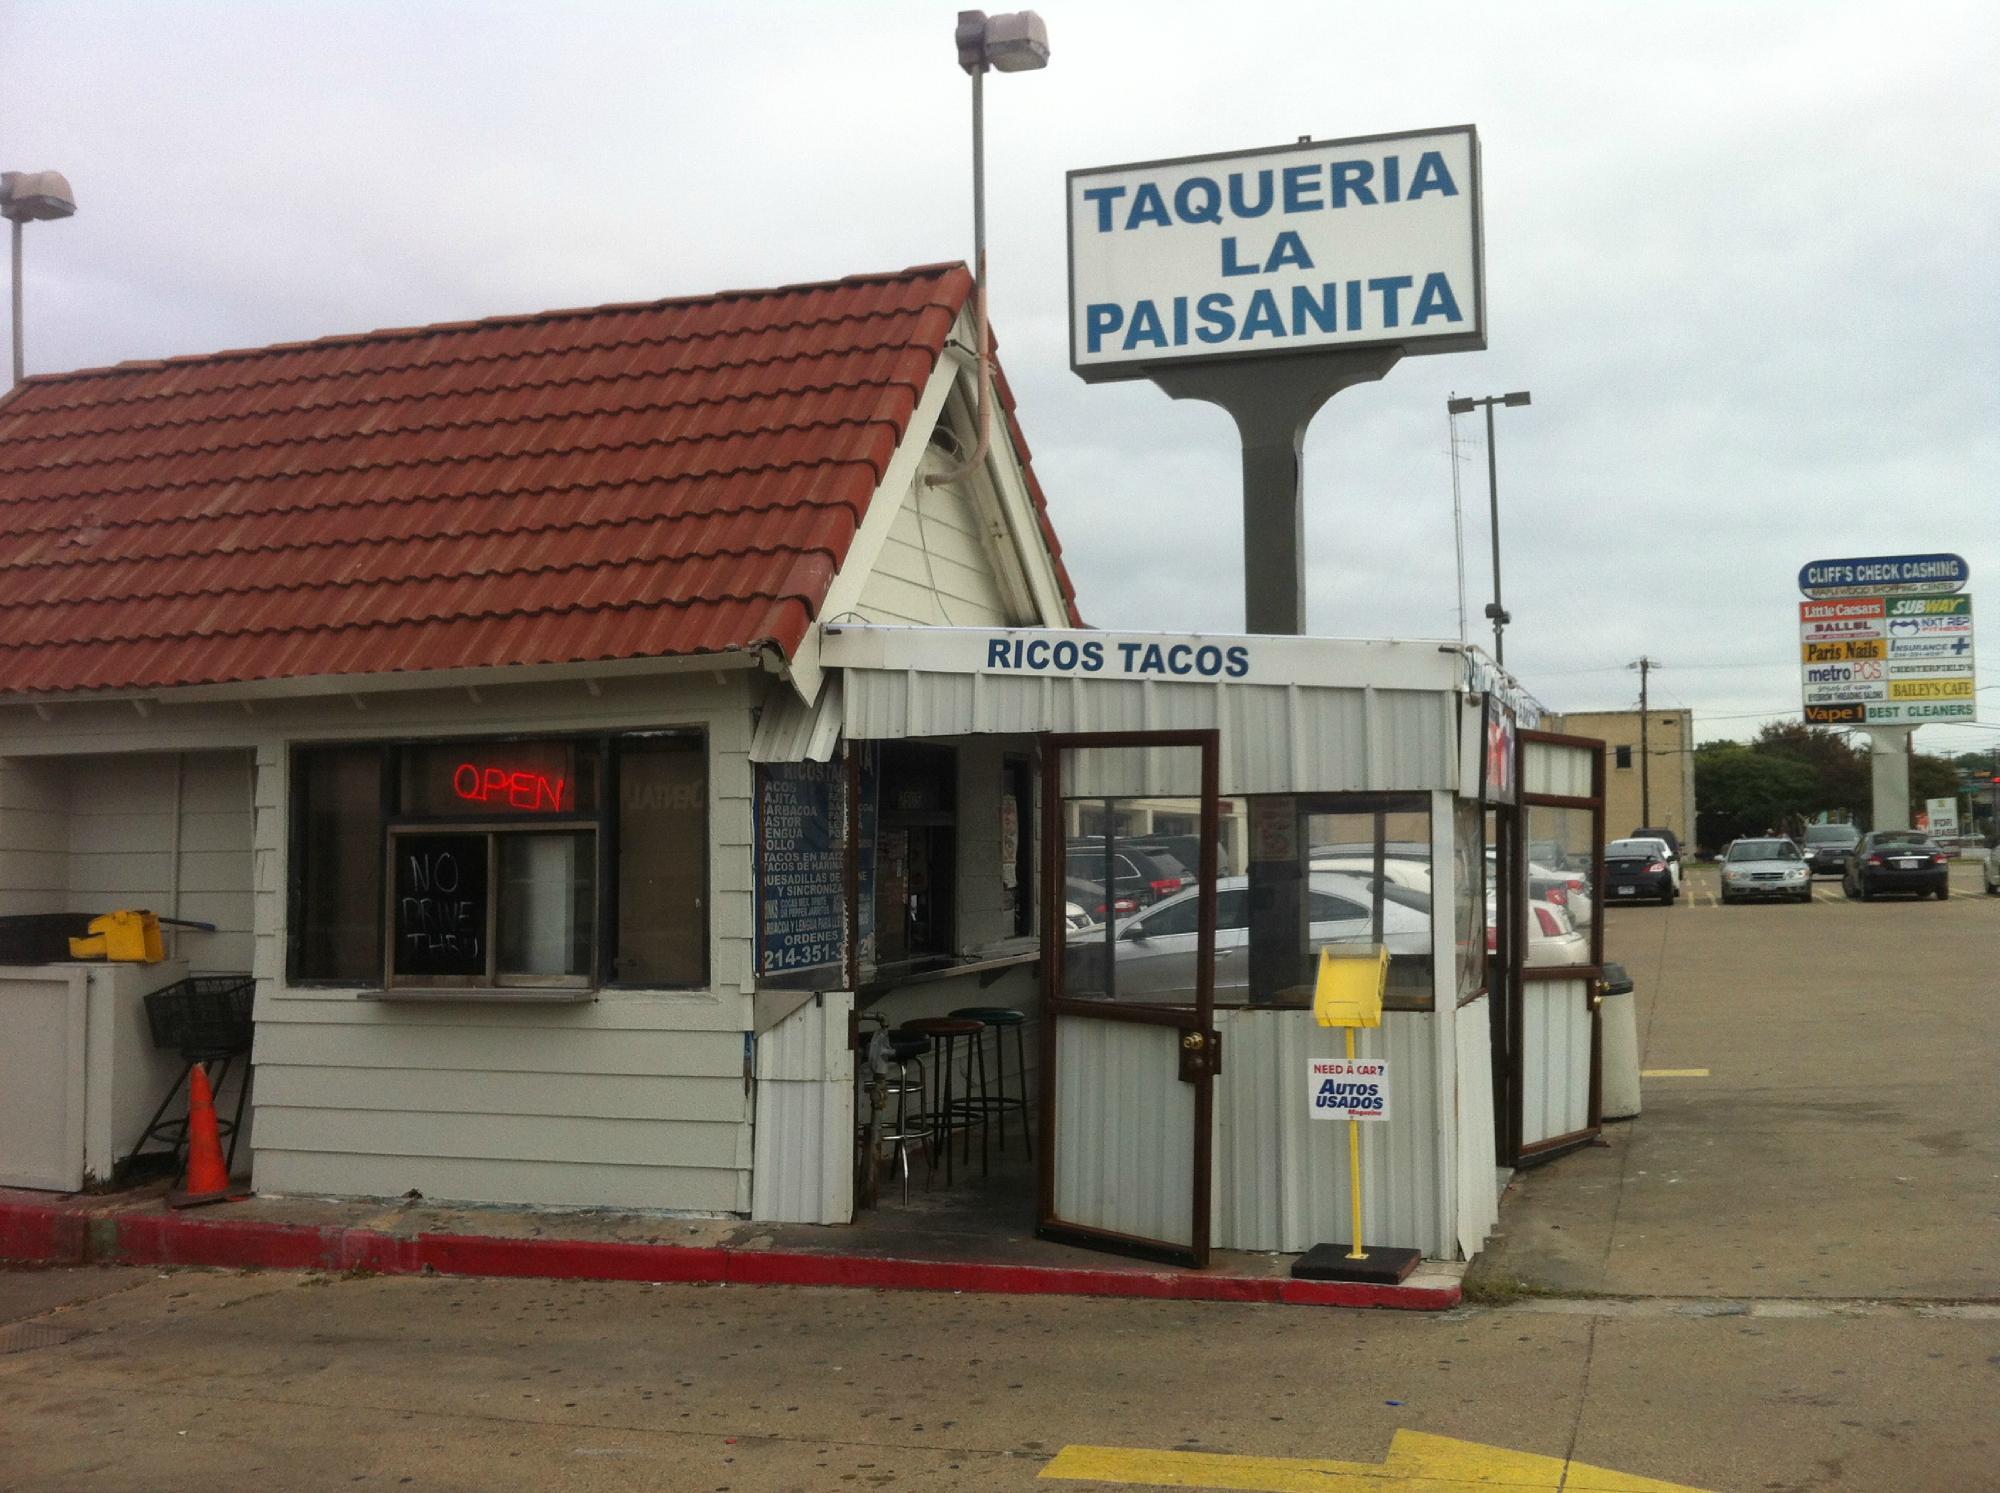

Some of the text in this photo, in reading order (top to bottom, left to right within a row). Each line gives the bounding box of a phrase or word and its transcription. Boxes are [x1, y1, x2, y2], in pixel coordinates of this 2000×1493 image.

[1083, 150, 1460, 234] TAQUERIA
[1220, 230, 1315, 277] LA
[1086, 271, 1464, 354] PAISANITA
[1808, 560, 1959, 584] CLIFF'S CHECK CASHING
[1804, 603, 1880, 618] Little Caesars
[1892, 598, 1964, 615] SUBWAY
[987, 638, 1249, 677] RICOS TACOS
[1807, 641, 1879, 663] Paris Nails
[1893, 682, 1972, 697] BAILEY'S CAFE
[1807, 707, 1855, 722] Vape
[1869, 704, 1973, 718] BEST CLEANERS
[454, 763, 565, 812] OPEN
[764, 781, 797, 794] ACOS
[764, 792, 798, 805] AJITA
[764, 804, 818, 817] ARBACOA
[764, 815, 801, 828] ASTOR
[765, 827, 804, 840] ENGUA
[765, 839, 796, 851] OLLO
[410, 852, 459, 893] NO
[764, 873, 828, 887] UESADILLAS
[402, 897, 473, 930] DRIVE
[784, 932, 839, 947] ORDENES
[1313, 1064, 1385, 1076] NEED A CAR?
[1315, 1095, 1384, 1109] USADOS
